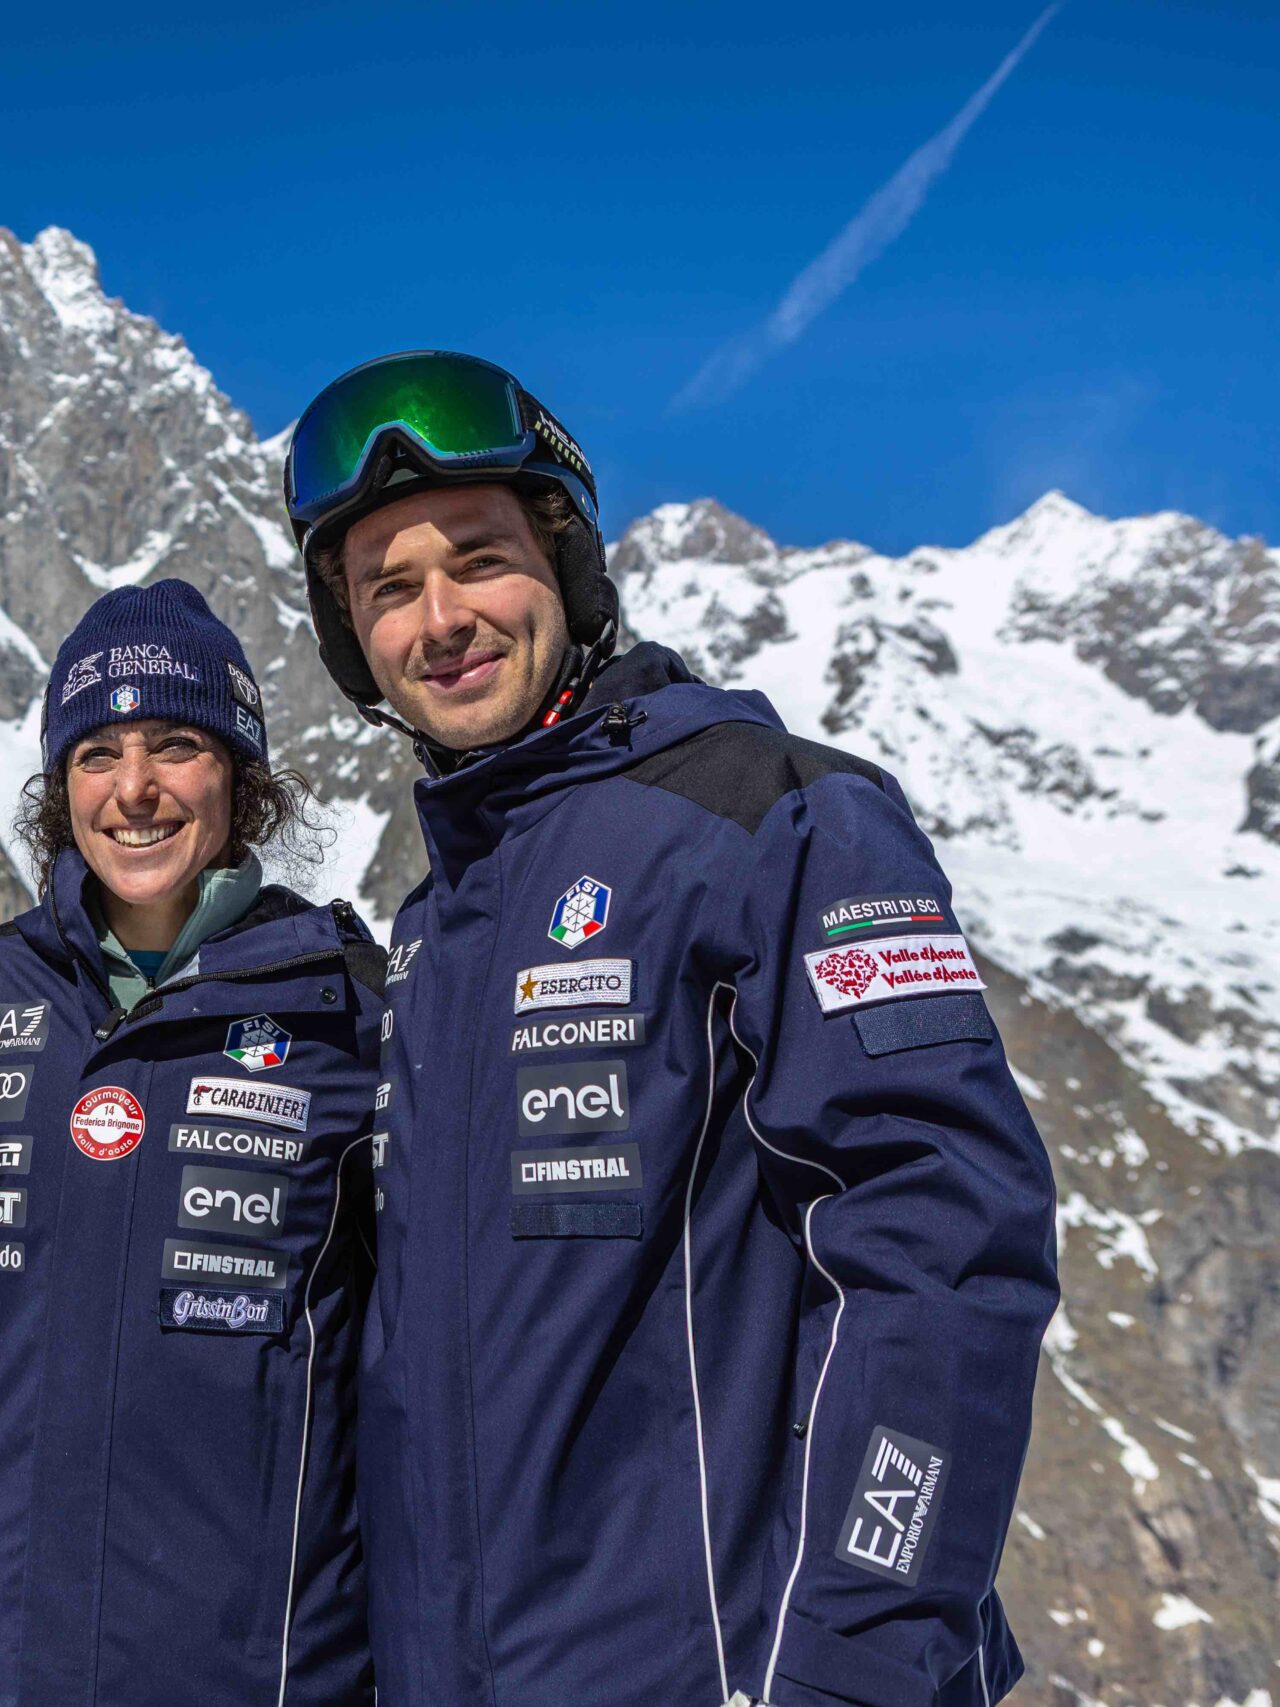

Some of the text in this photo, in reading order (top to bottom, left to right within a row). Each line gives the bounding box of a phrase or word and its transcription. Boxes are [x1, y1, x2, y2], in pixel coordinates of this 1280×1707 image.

[108, 643, 173, 664] BANCA
[236, 706, 261, 741] EA7
[566, 881, 600, 901] FISI
[822, 899, 940, 929] MAESTRI DI SCI
[878, 949, 920, 967] Valle
[539, 974, 622, 996] ESERCITO
[881, 970, 933, 989] Vallée
[243, 1019, 281, 1037] FISI
[512, 1018, 636, 1052] FALCONERI
[81, 1091, 139, 1116] courmayeur
[104, 1105, 115, 1116] 14
[210, 1087, 307, 1122] CARABINIERI
[522, 1074, 625, 1123] enel
[75, 1116, 140, 1131] Federica Brignone
[77, 1133, 96, 1153] valle
[176, 1129, 304, 1163] FALCONERI
[538, 1157, 630, 1182] FINSTRAL
[184, 1186, 281, 1227] enel
[191, 1255, 276, 1278] FINSTRAL
[847, 1436, 923, 1568] EA7
[896, 1455, 944, 1575] EMPORIO ARMANI
